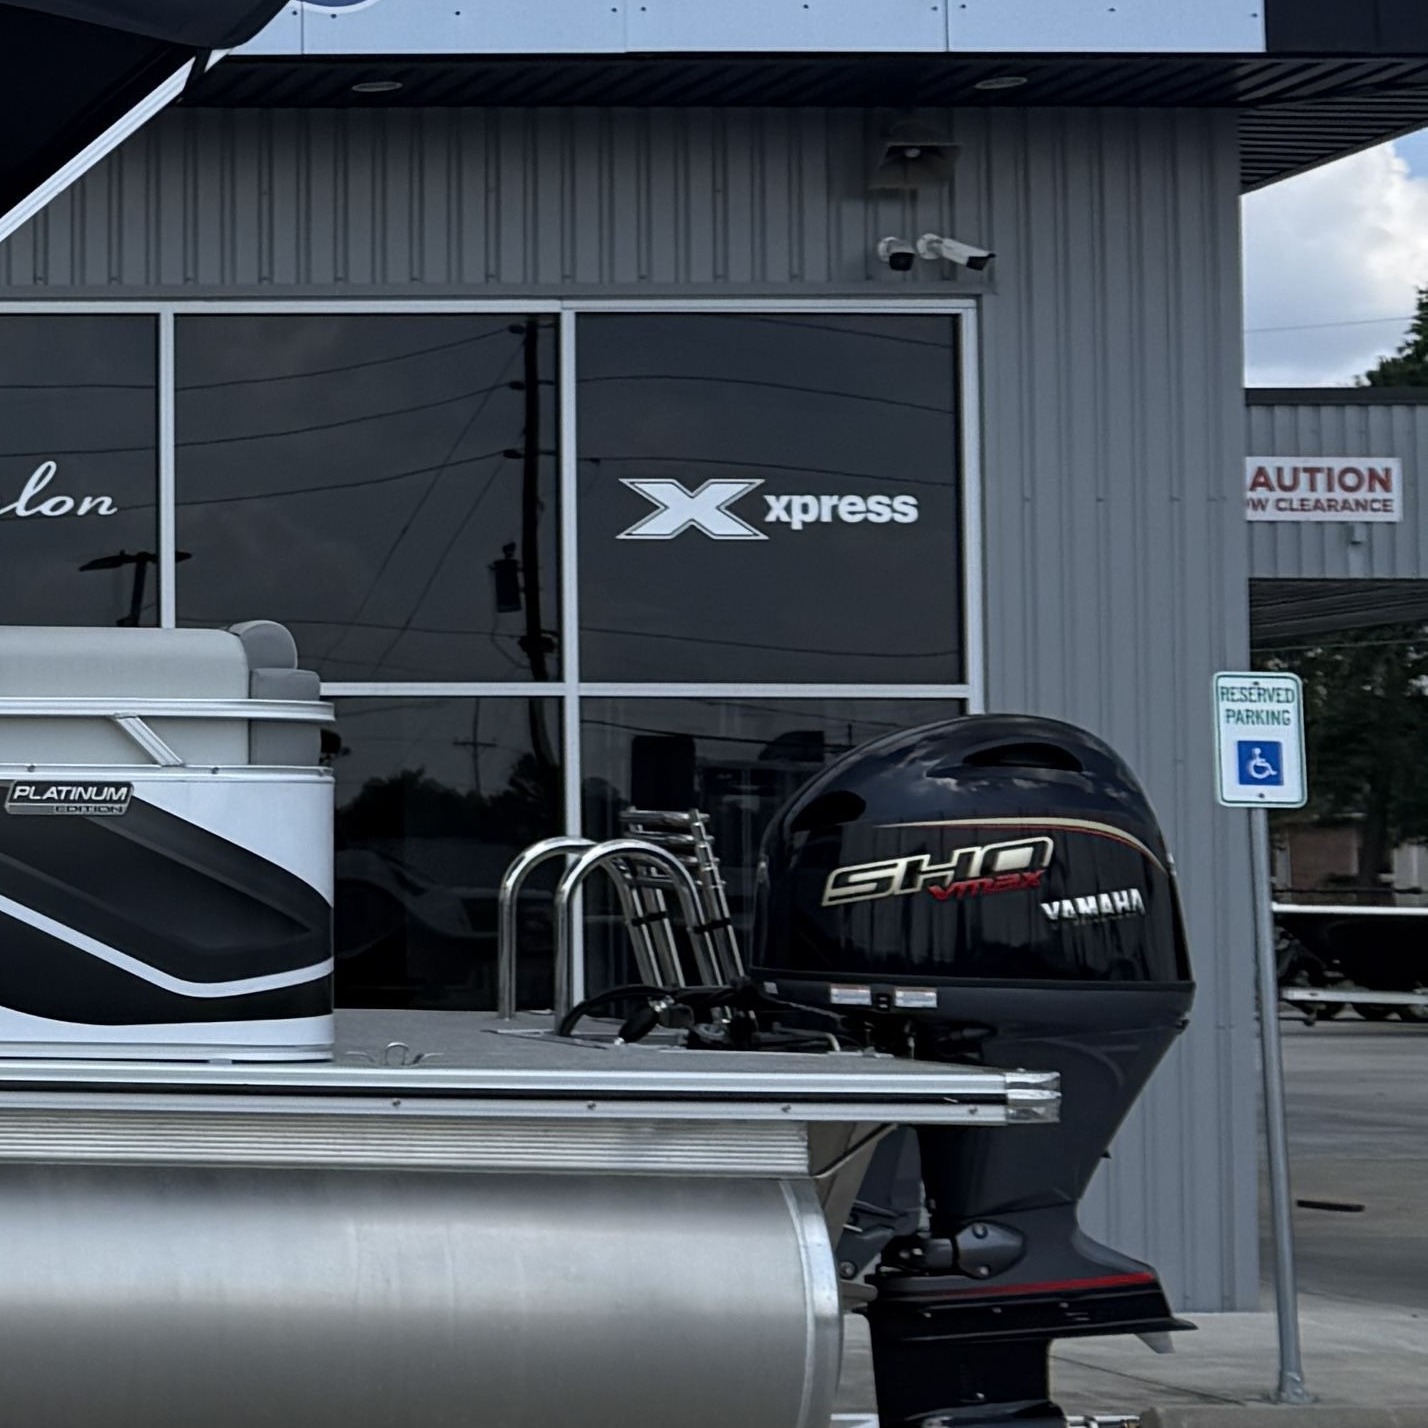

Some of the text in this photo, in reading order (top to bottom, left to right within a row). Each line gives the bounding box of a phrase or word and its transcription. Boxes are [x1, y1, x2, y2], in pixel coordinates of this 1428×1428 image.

[1248, 465, 1394, 494] AUTION
[764, 492, 919, 531] xpress
[1274, 497, 1395, 514] CLEARANCE
[1220, 685, 1296, 704] RESERVED
[1225, 708, 1292, 727] PARKING
[12, 785, 129, 801] PLATINUM
[54, 805, 124, 814] EDITION
[821, 836, 1054, 907] SHO
[1041, 887, 1147, 923] YAMAHA
